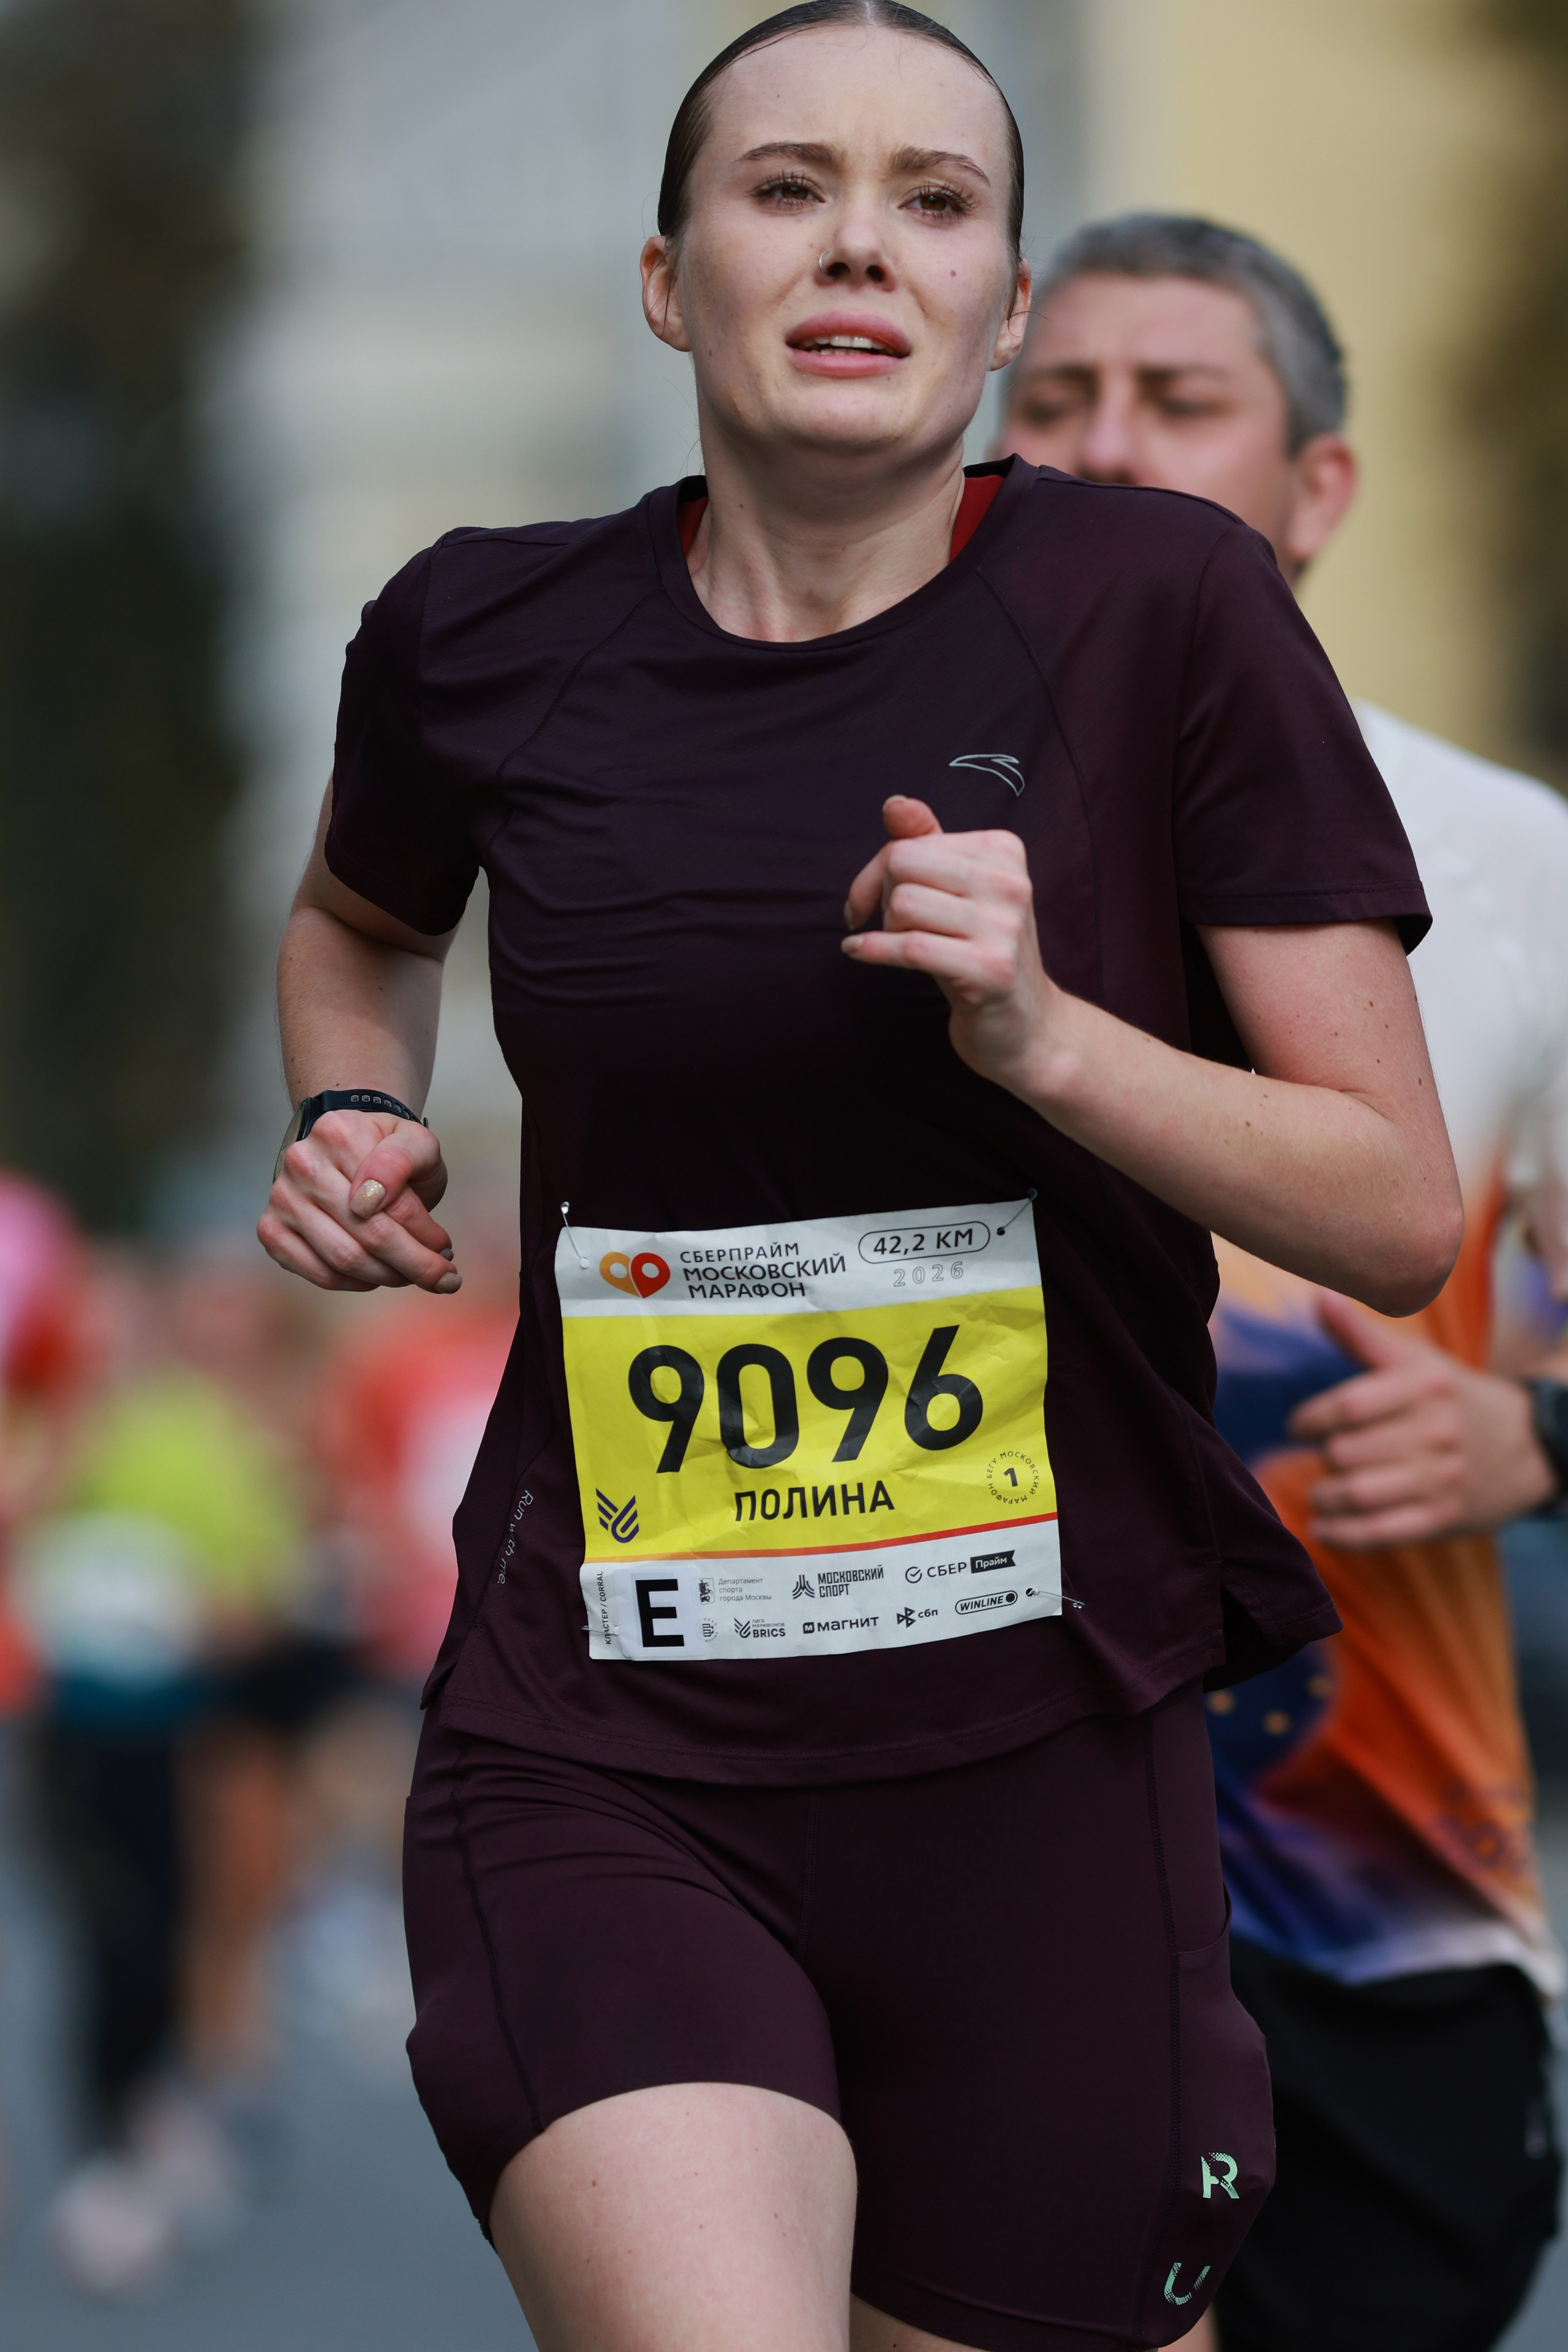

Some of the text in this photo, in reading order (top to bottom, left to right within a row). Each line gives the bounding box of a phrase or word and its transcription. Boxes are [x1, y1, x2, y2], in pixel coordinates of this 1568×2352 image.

[680, 1242, 799, 1264] СБЕРПРАЙМ
[873, 1234, 925, 1255] 42,2
[683, 1252, 846, 1281] МОСКОВСКИЙ
[894, 1261, 963, 1287] 2026
[688, 1282, 805, 1298] МАРАФОН
[628, 1324, 983, 1474] 9096
[987, 1450, 1039, 1504] БЕГУ МОСКОВСКИЙ МАРАФОН
[1003, 1468, 1018, 1487] 1
[514, 1490, 533, 1520] Run
[735, 1480, 895, 1522] ПОЛИНА
[818, 1564, 884, 1585] МОСКОВСКИЙ
[927, 1556, 1008, 1578] СБЕР Прайм
[597, 1571, 606, 1602] CORRAL
[819, 1583, 850, 1598] СПОРТ
[918, 1609, 938, 1618] сбп
[960, 1596, 1004, 1611] WINLINE
[601, 1609, 611, 1645] КЛАСТЕР
[753, 1628, 786, 1638] BRICS
